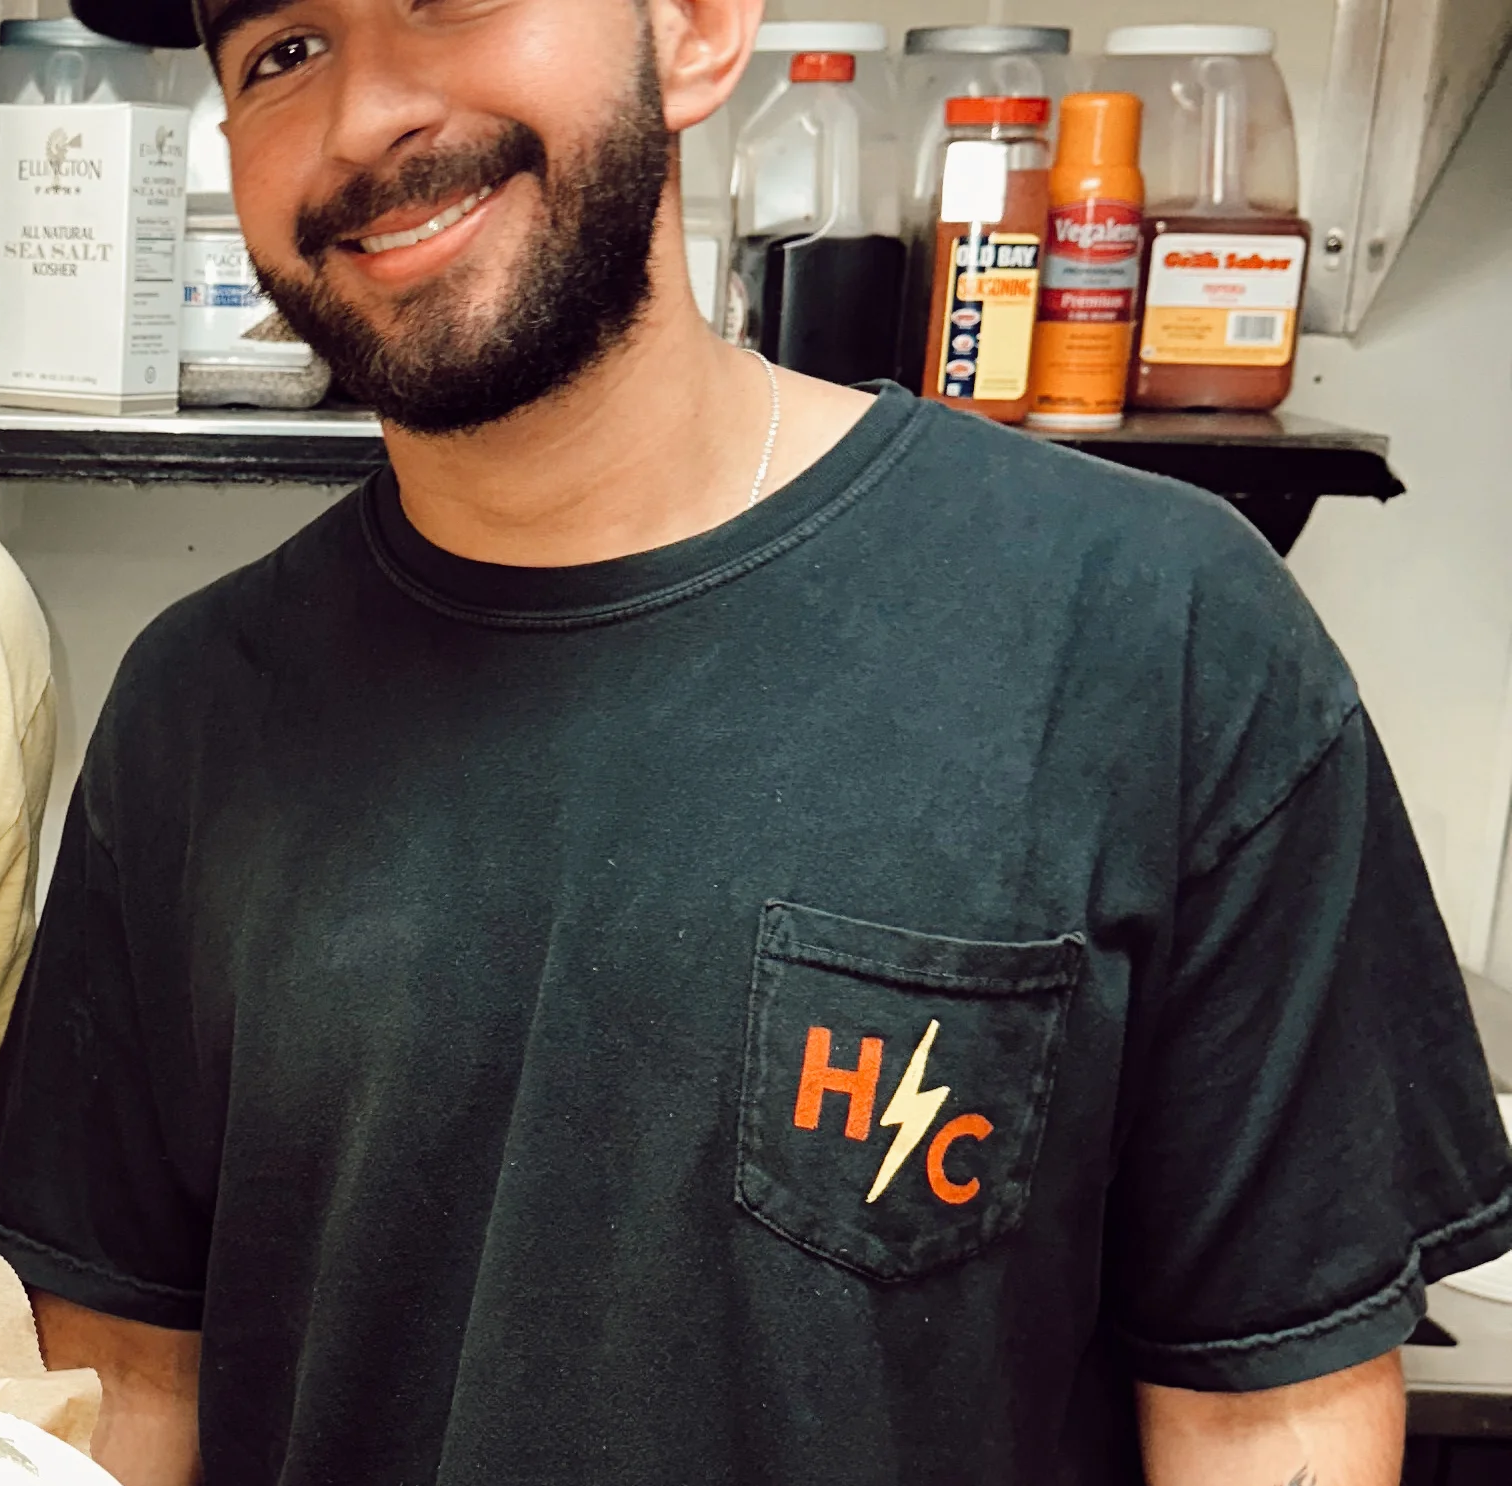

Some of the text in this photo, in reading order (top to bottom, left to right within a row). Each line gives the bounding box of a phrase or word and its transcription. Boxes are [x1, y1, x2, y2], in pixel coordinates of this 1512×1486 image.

[18, 159, 103, 181] ELLINGTON
[43, 226, 95, 240] NATURAL
[3, 241, 114, 262] SEA SALT
[997, 245, 1037, 267] BAY
[32, 262, 78, 277] KOSHER
[957, 277, 1032, 297] SASONING
